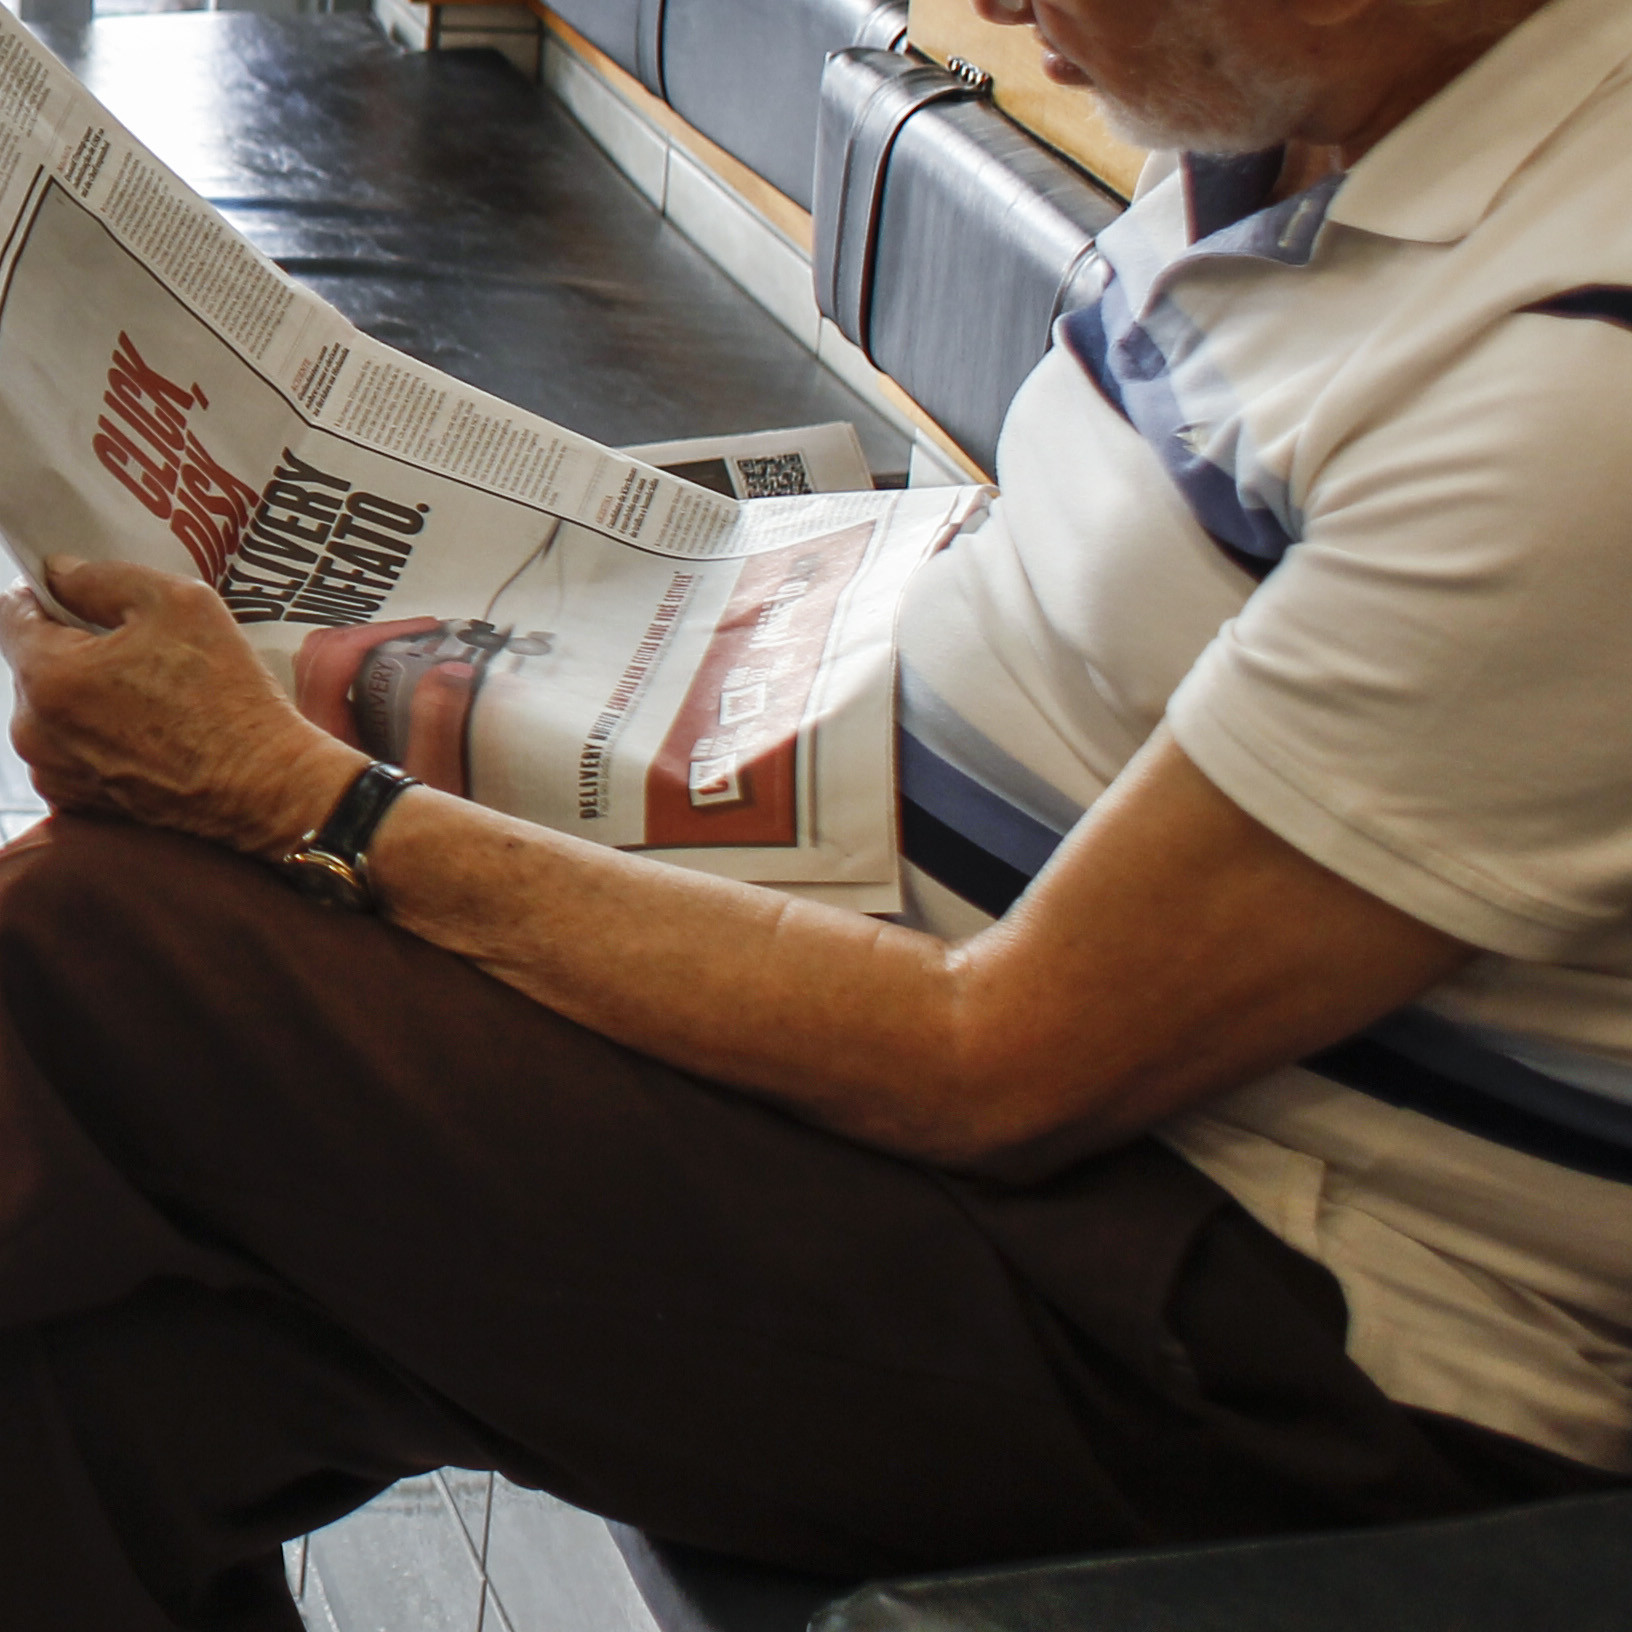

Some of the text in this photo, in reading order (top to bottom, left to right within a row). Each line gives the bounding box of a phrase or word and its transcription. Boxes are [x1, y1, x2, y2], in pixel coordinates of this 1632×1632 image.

[92, 330, 209, 520] CLICK,
[171, 429, 261, 587] DISK
[218, 446, 351, 623] DELIVERY
[282, 491, 430, 626] MUFFATO.
[579, 742, 603, 819] DELIVERY
